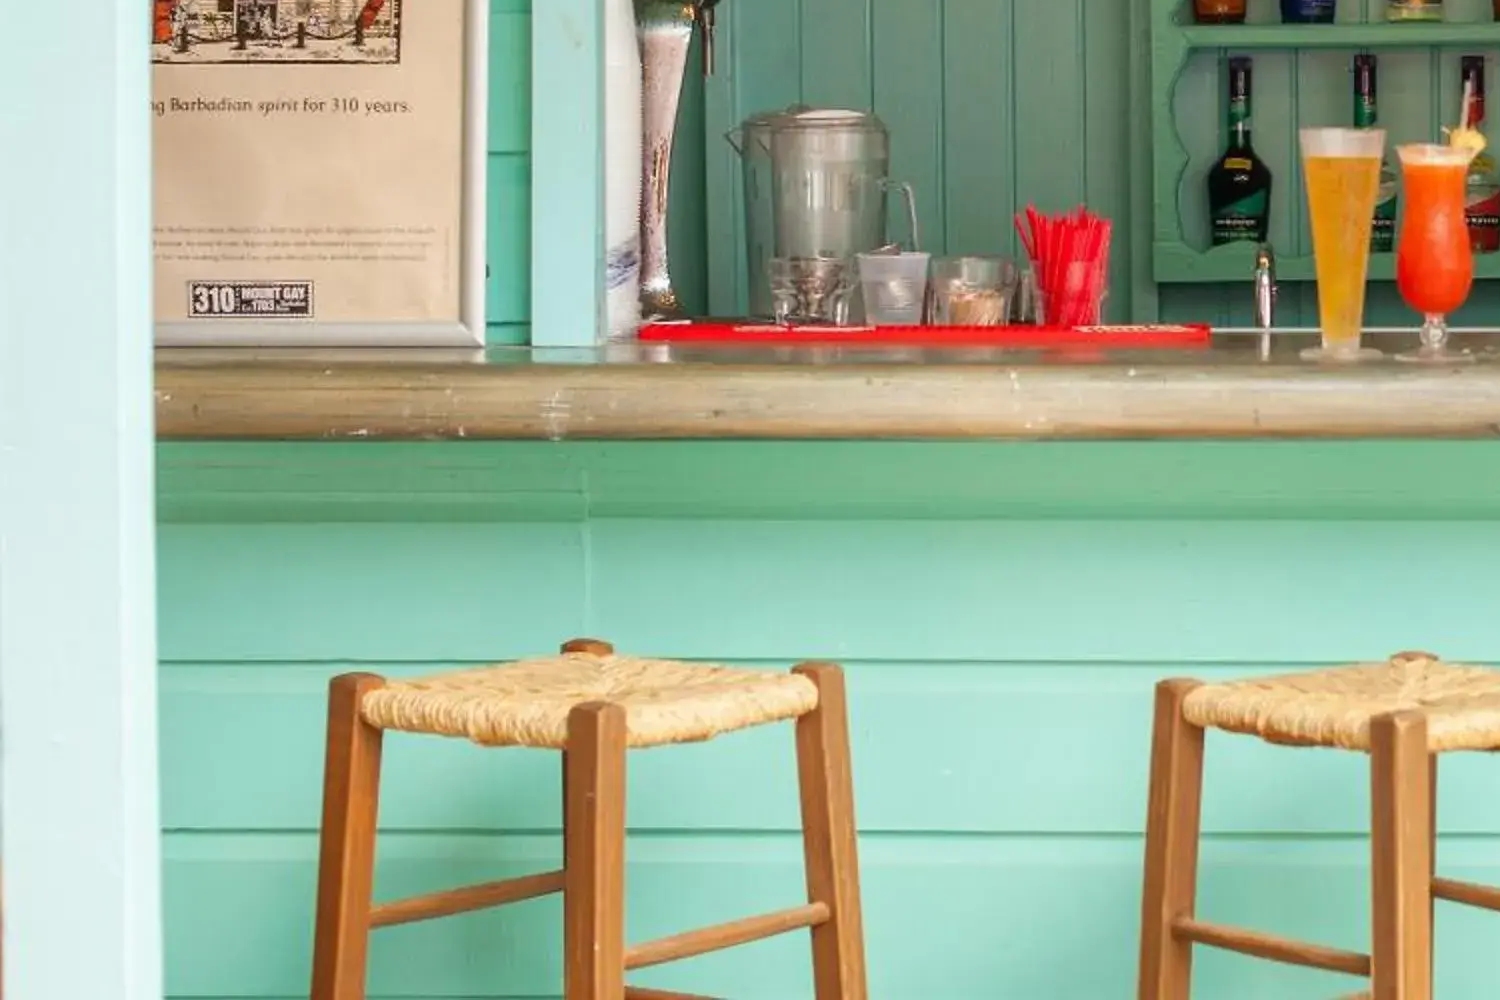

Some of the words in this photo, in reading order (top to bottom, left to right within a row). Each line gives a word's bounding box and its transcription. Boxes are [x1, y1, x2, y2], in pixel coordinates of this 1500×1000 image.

[170, 97, 252, 112] Barbadian
[258, 98, 298, 116] spirit
[303, 98, 325, 113] for
[331, 99, 359, 113] 310
[364, 101, 412, 116] years.
[194, 285, 236, 314] 310
[283, 287, 306, 300] GAY
